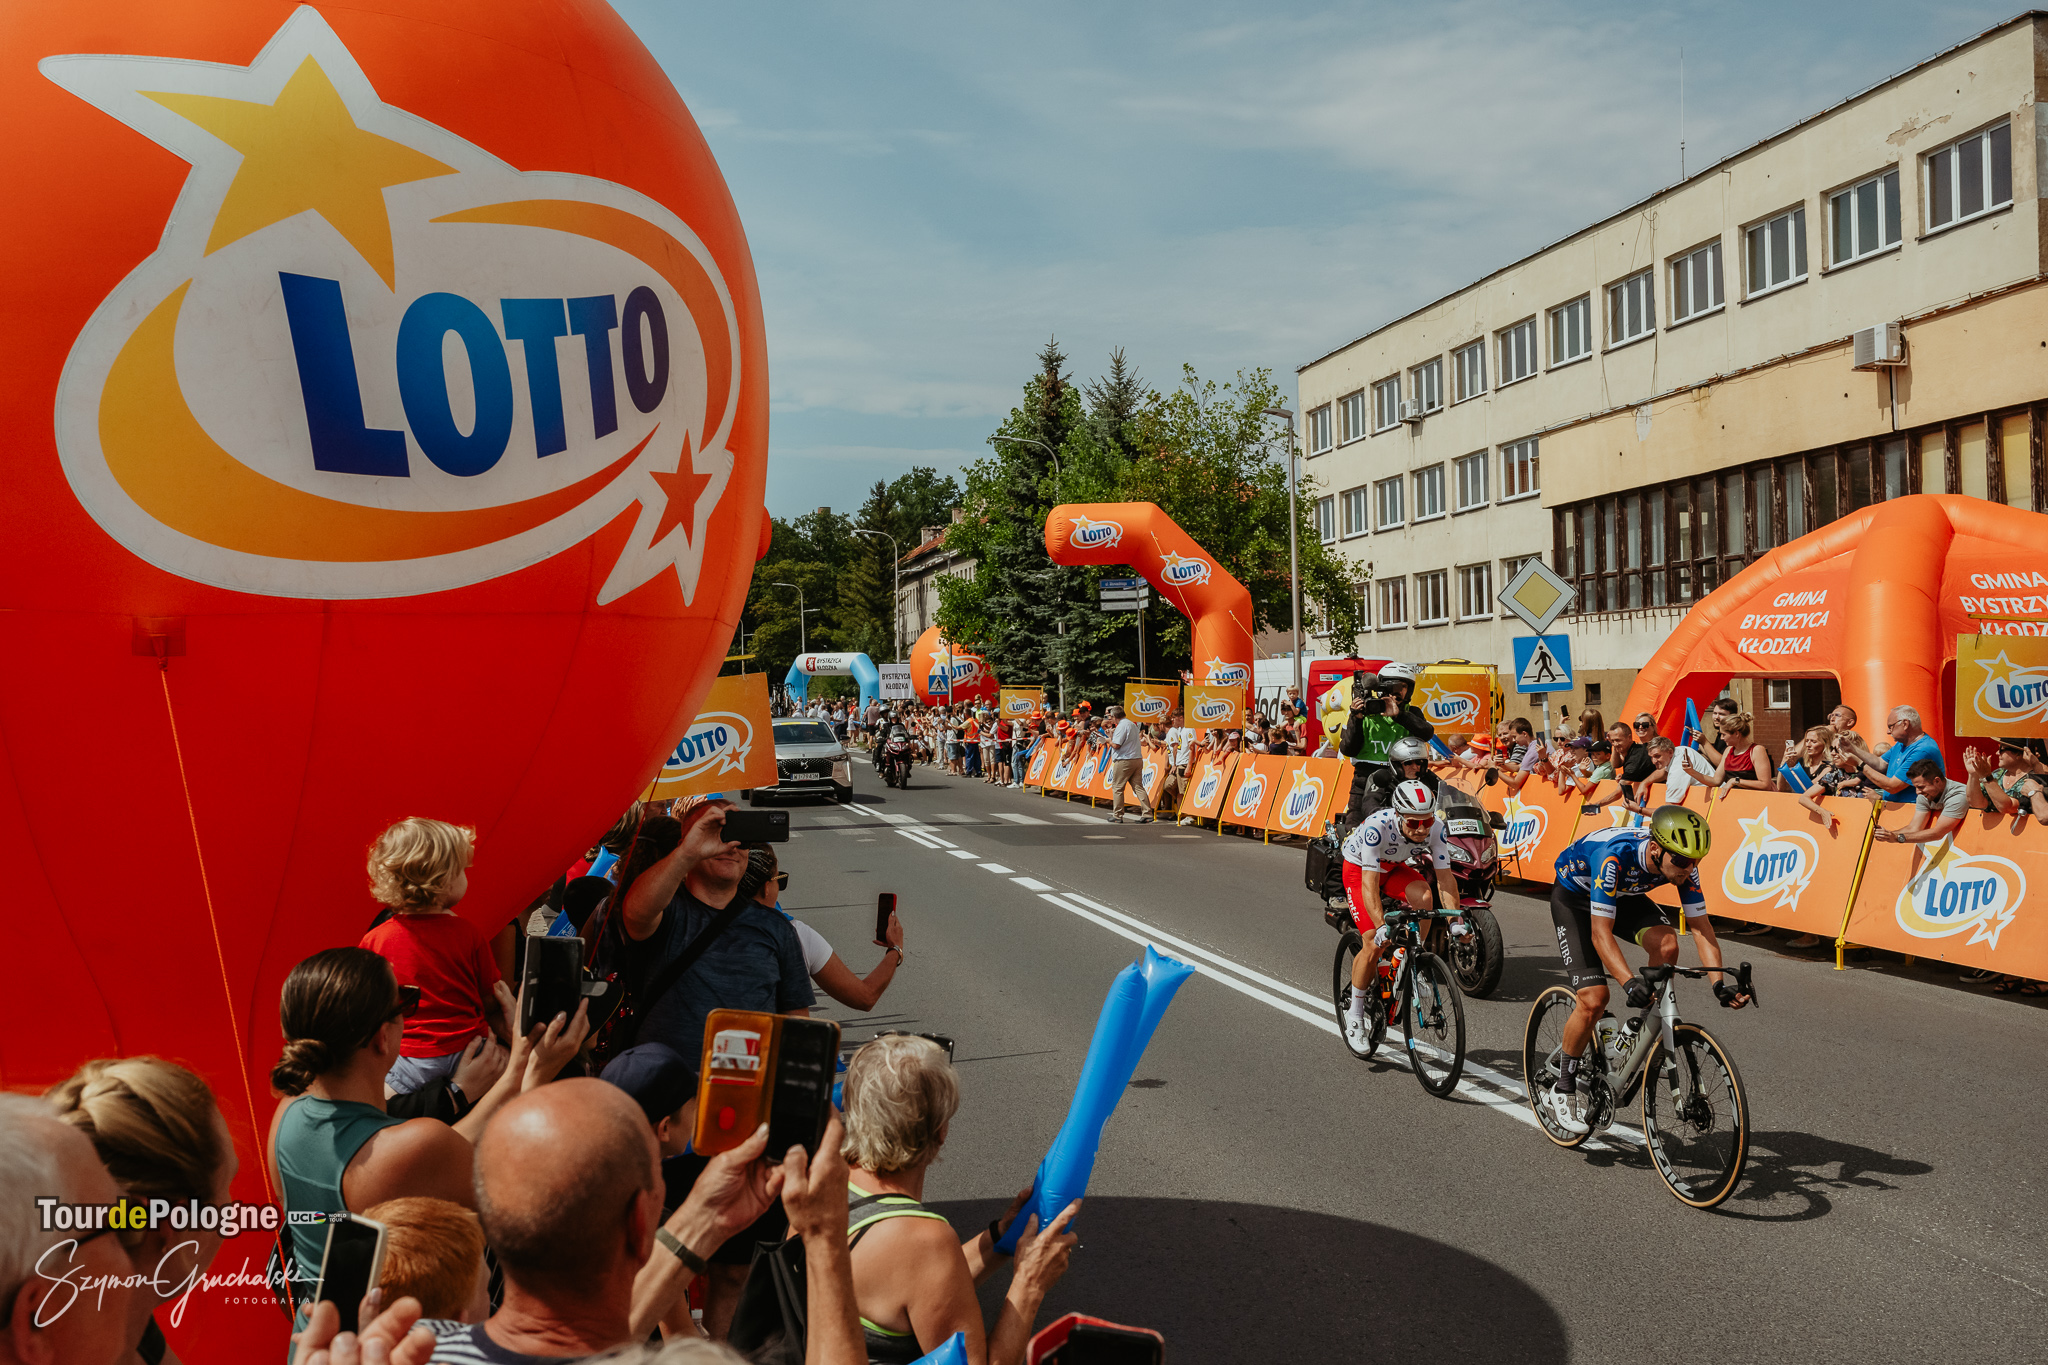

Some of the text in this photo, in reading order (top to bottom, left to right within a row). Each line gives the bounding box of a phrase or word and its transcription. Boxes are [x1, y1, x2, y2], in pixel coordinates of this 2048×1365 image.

[278, 271, 669, 478] LOTTO
[1082, 526, 1112, 543] LOTTO
[1172, 563, 1202, 580] LOTTO
[1970, 571, 2048, 590] GMINA
[1773, 589, 1827, 607] GMINA
[1740, 610, 1830, 629] BYSTRZYCA
[1737, 636, 1811, 654] KŁODZKA
[882, 673, 911, 681] BYSTRZYCA
[885, 682, 909, 690] KŁODZKA
[1215, 668, 1244, 685] LOTTO
[1012, 702, 1030, 711] LOTTO
[1140, 701, 1163, 712] LOTTO
[1201, 703, 1226, 717] LOTTO
[1433, 698, 1468, 718] LOTTO
[1370, 740, 1392, 754] TV
[1200, 779, 1217, 798] LOTTO
[1240, 784, 1260, 806] LOTTO
[1289, 789, 1316, 816] LOTTO
[1502, 818, 1536, 845] LOTTO
[1603, 862, 1616, 888] LOTTO
[1743, 849, 1798, 885] LOTTO
[1924, 877, 1997, 918] LOTTO
[1560, 939, 1573, 966] UBS
